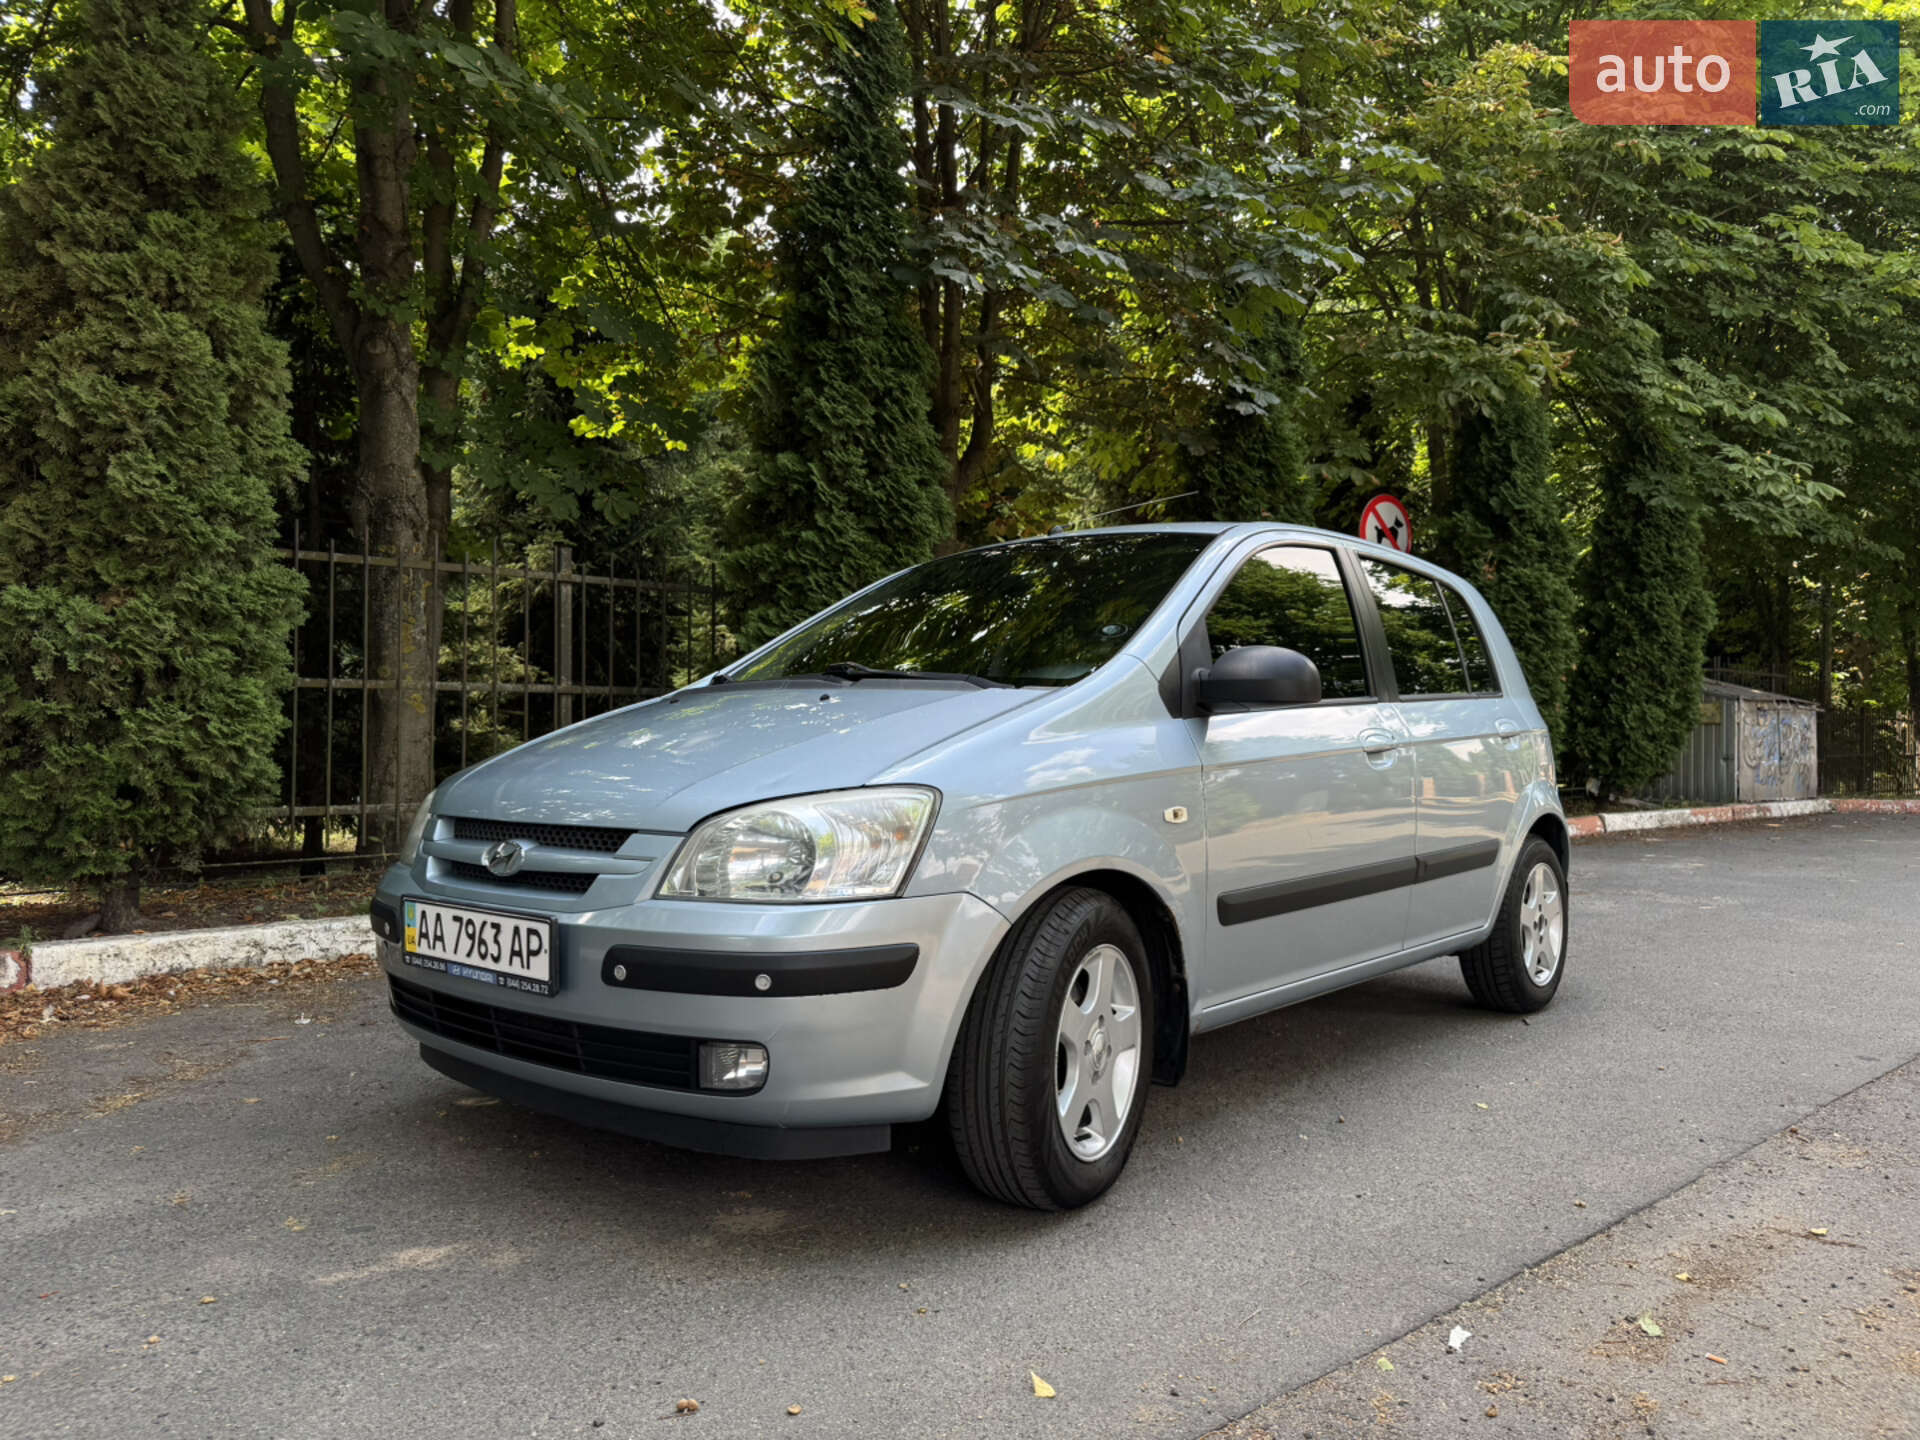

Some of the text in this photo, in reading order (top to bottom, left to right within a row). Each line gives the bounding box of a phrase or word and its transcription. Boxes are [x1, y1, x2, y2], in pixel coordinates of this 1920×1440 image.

[417, 909, 543, 970] AA 7963 AP
